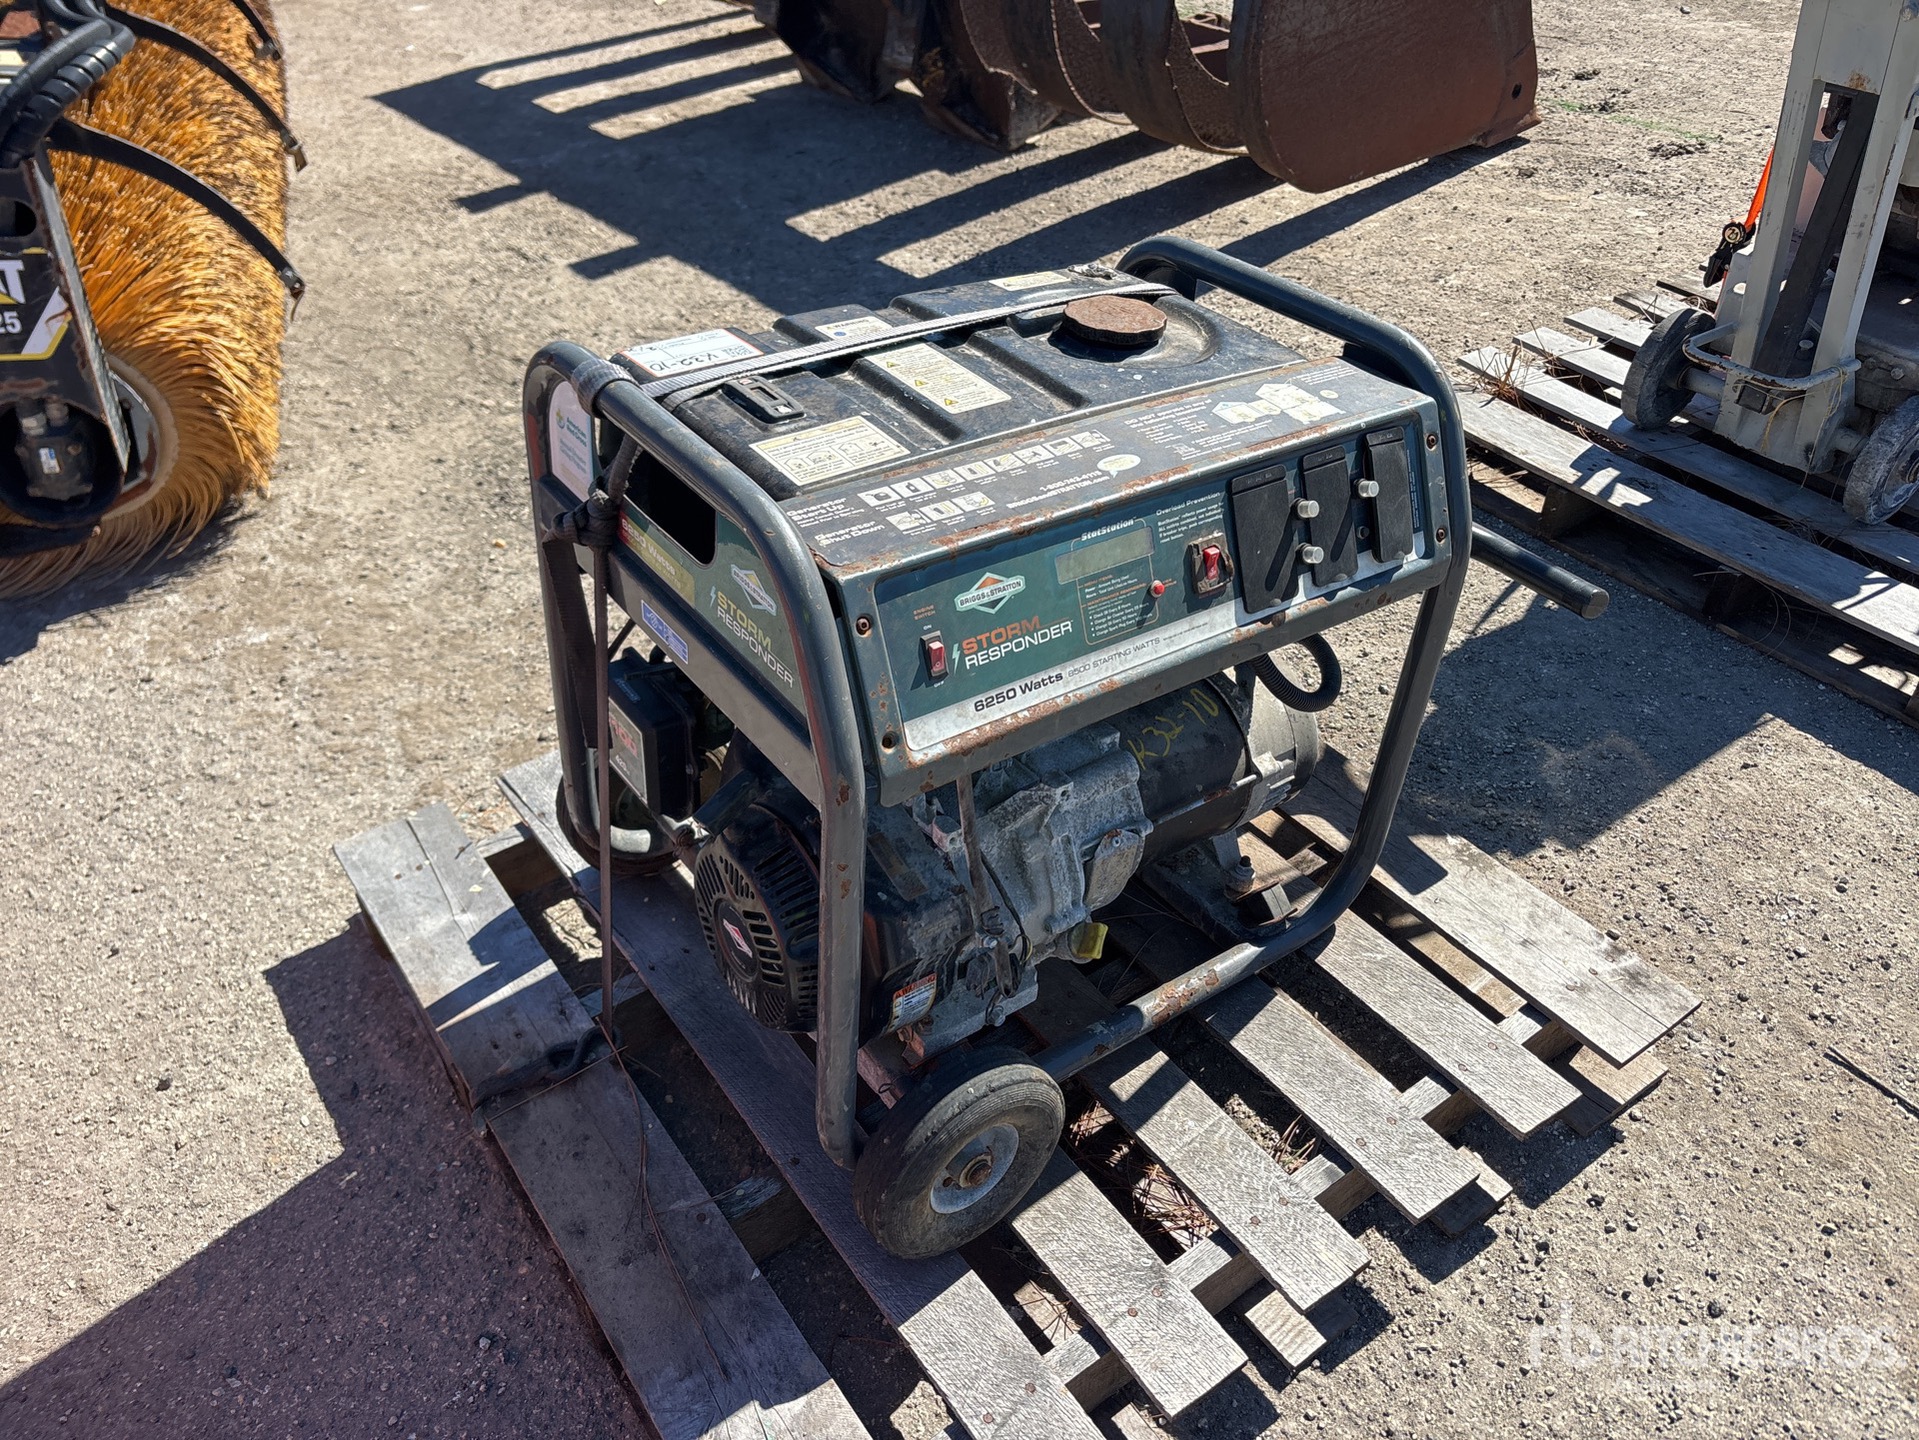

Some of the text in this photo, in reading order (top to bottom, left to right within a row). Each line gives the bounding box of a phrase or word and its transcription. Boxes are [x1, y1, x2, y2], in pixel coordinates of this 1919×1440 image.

[1156, 492, 1221, 516] Overload Prevention
[814, 521, 876, 540] Generator
[850, 524, 885, 537] Down
[717, 591, 772, 652] STORM
[961, 615, 1041, 655] STORM
[717, 606, 793, 688] RESPONDER
[964, 620, 1074, 670] RESPONDER
[974, 637, 1161, 713] 6250 Watts 8500 STARTING WATTS
